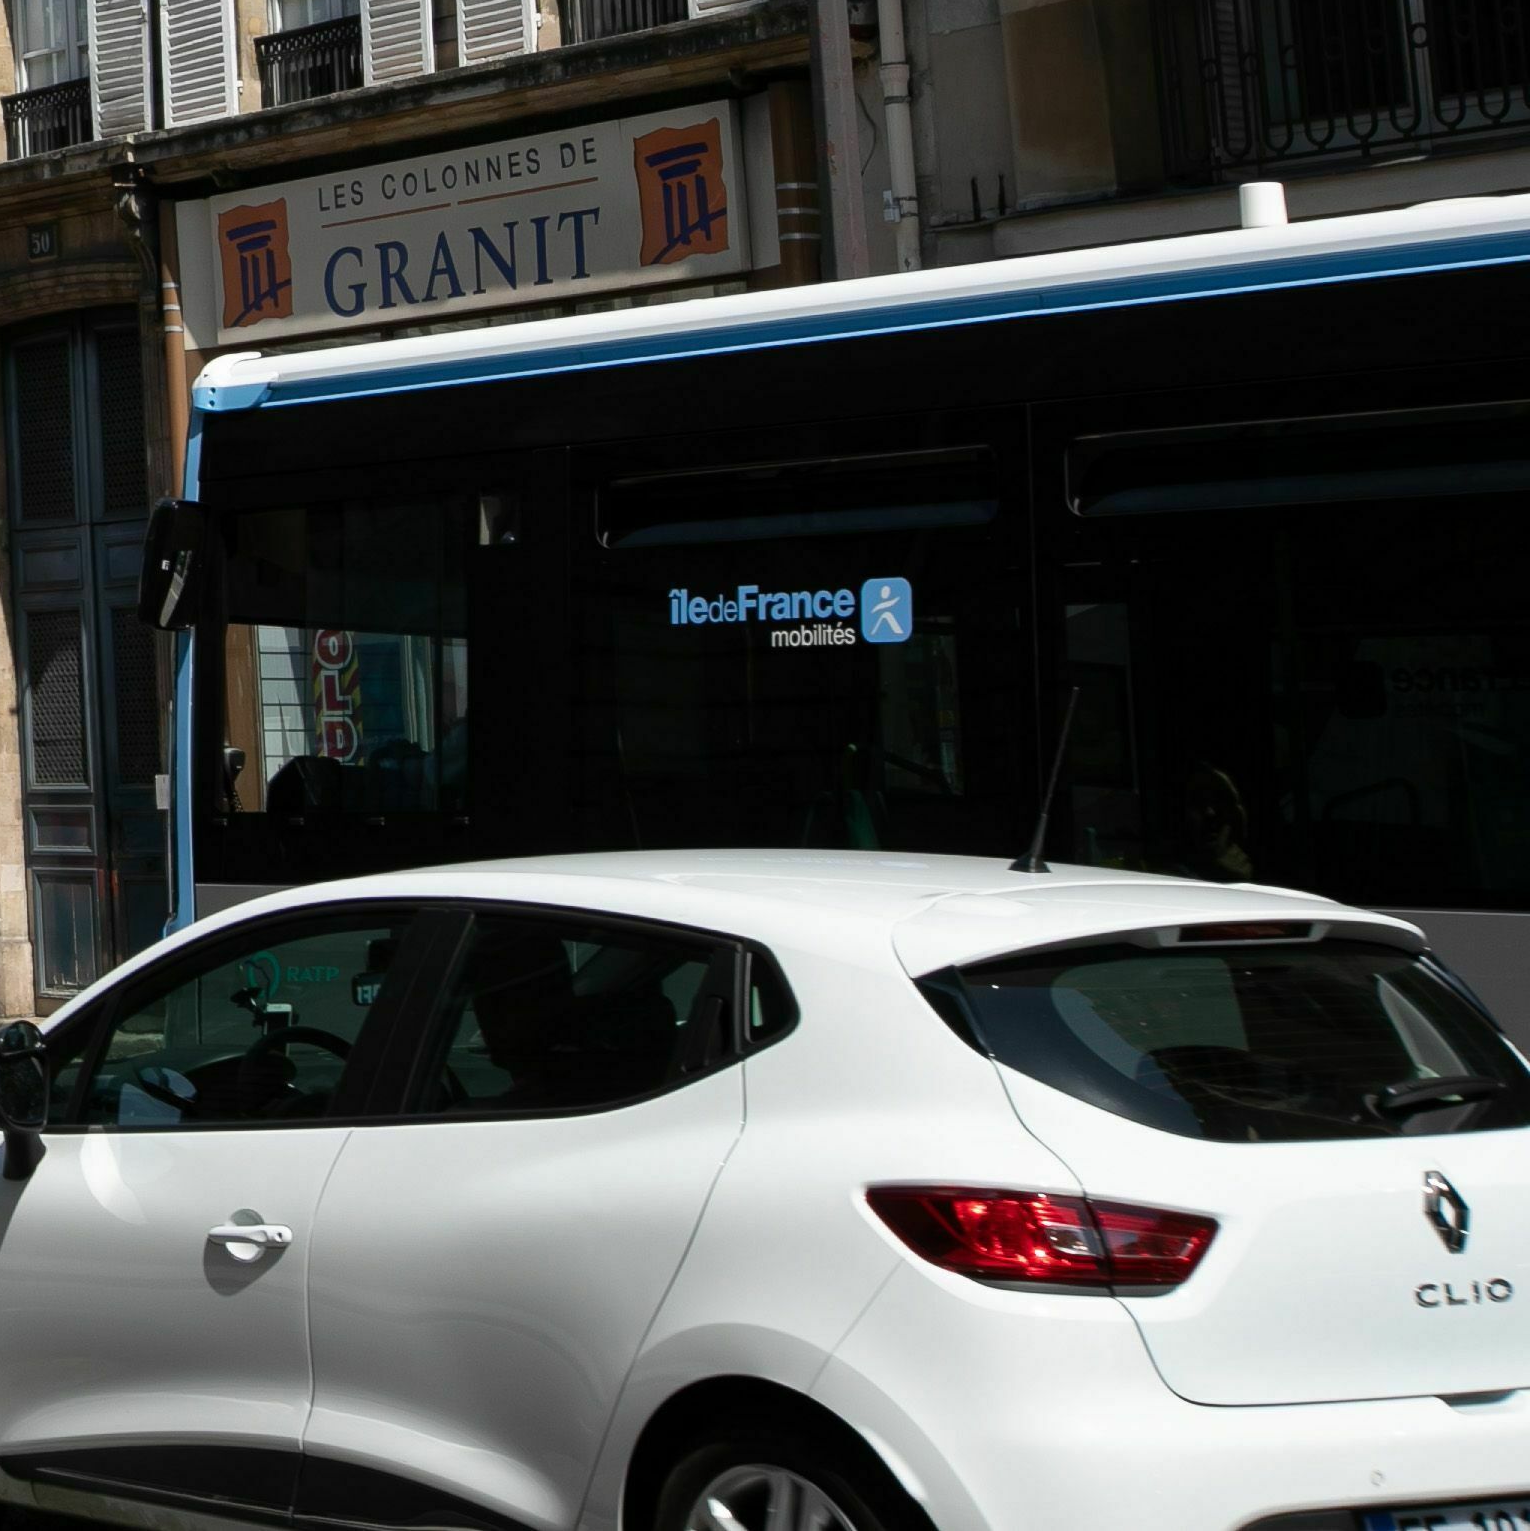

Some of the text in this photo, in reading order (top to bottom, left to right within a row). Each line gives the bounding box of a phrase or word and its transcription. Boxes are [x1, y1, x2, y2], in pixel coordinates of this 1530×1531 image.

[318, 137, 598, 212] LES COLONNES DE
[323, 206, 600, 318] GRANIT
[771, 621, 856, 648] mobilités
[286, 965, 340, 982] RATP
[1413, 1277, 1514, 1308] CLIO
